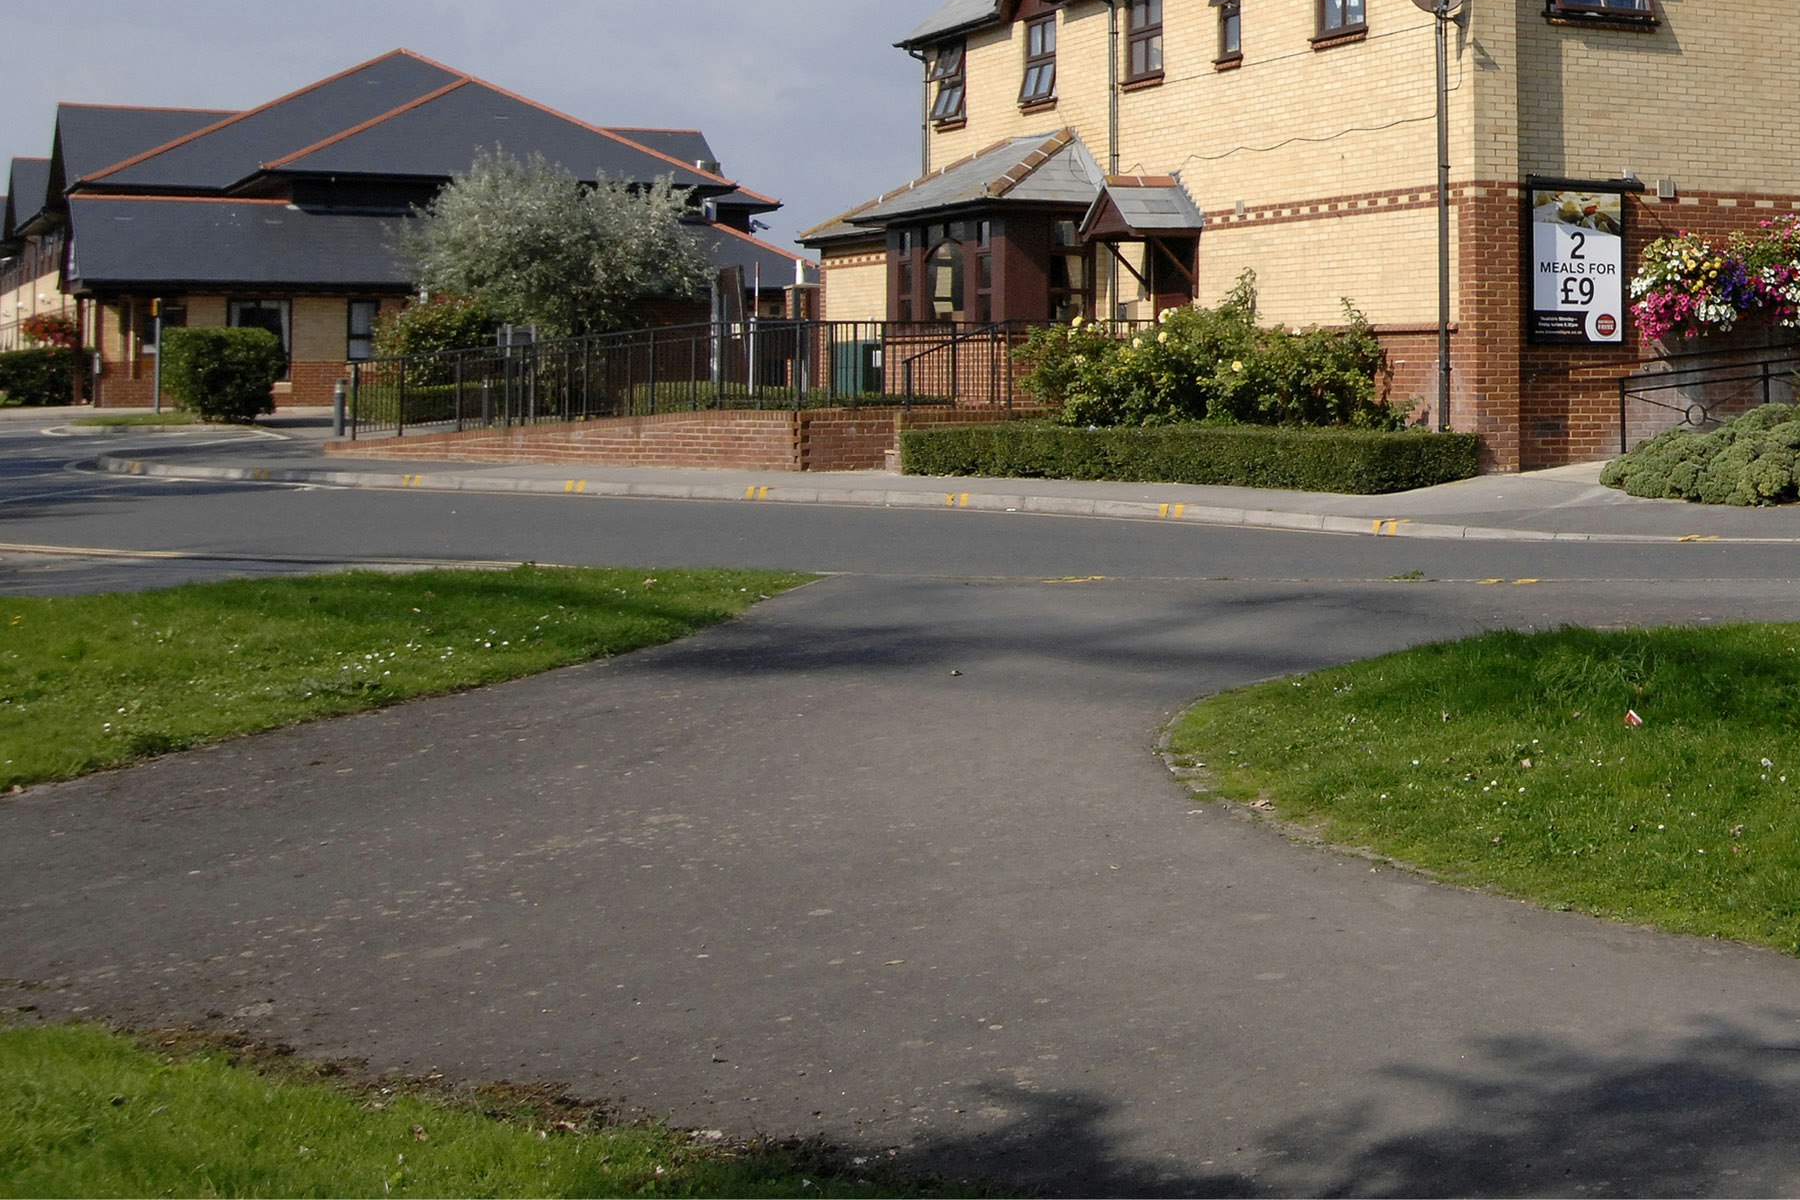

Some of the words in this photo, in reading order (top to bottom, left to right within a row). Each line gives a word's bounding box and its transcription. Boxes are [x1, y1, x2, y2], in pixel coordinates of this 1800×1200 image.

[1570, 231, 1585, 259] 2
[1540, 261, 1585, 274] MEALS
[1589, 263, 1616, 275] FOR
